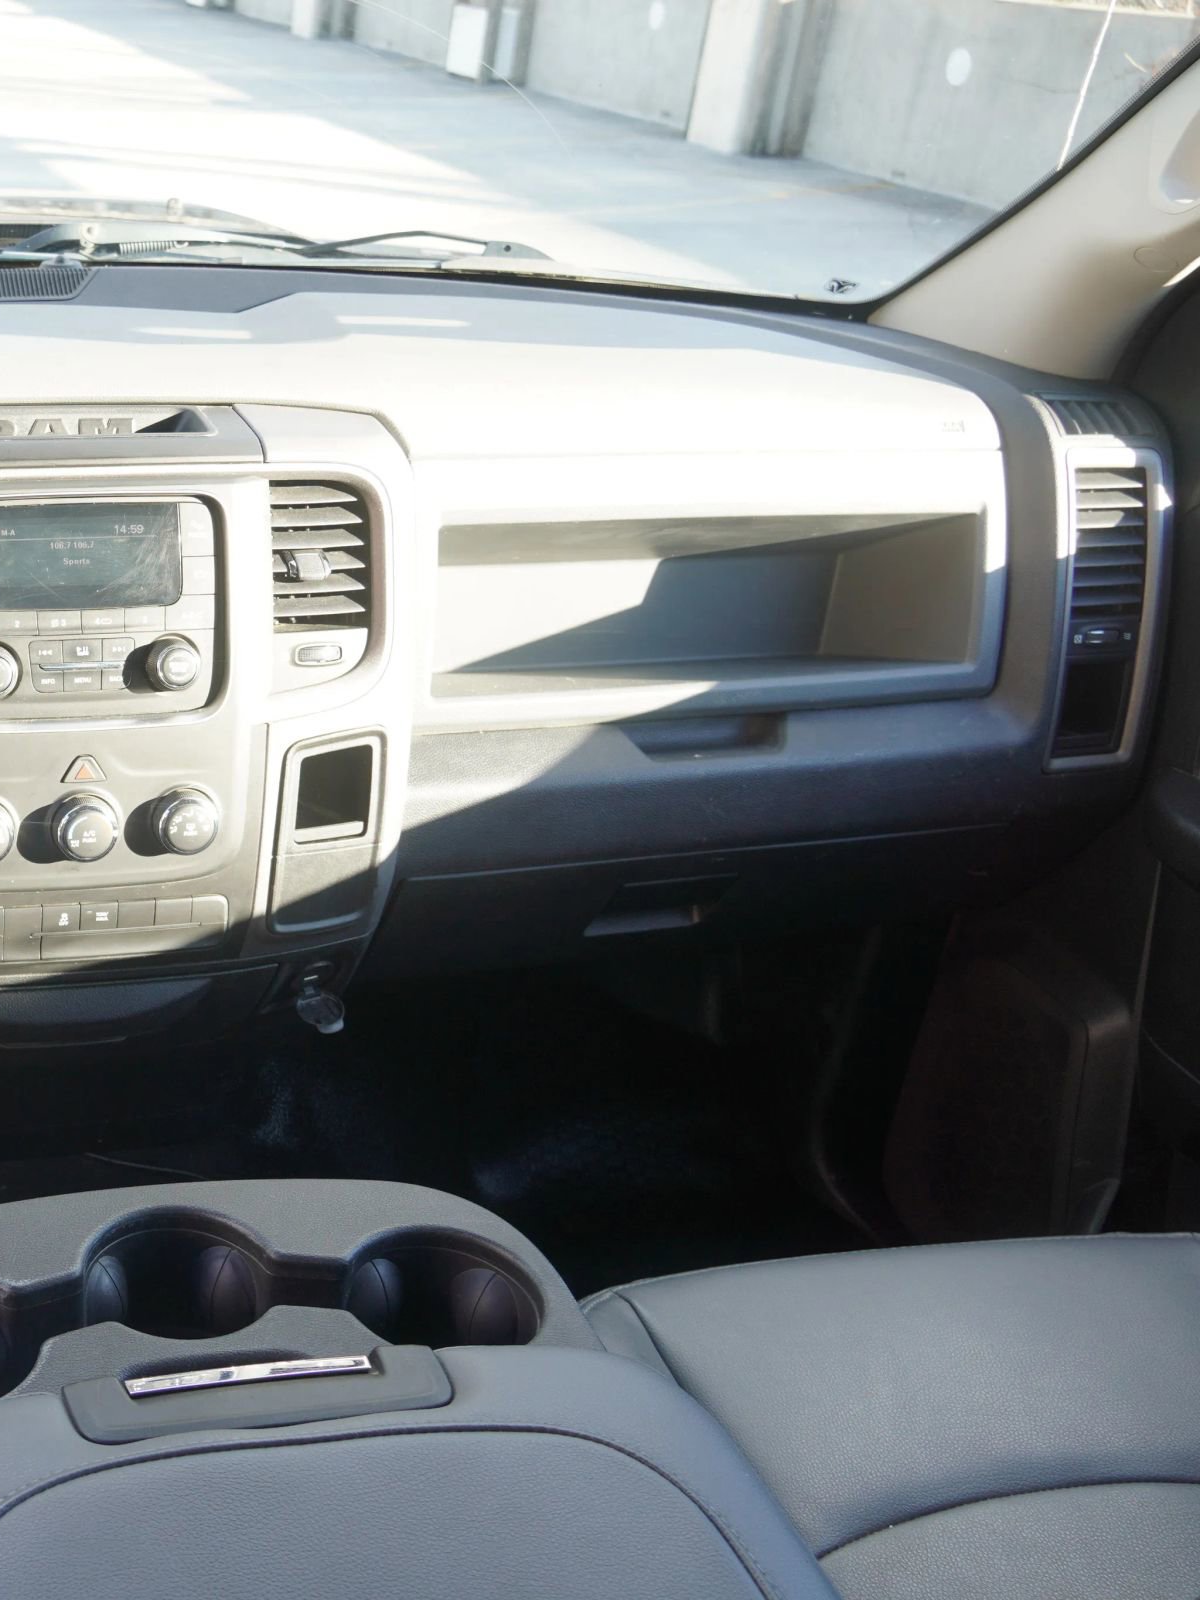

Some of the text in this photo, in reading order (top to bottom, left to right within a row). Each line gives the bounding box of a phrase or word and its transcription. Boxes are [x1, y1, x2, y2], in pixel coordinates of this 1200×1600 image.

[113, 524, 145, 535] 14:59
[63, 557, 91, 566] Sports
[15, 620, 20, 628] 2
[60, 619, 66, 627] 3
[74, 676, 92, 684] MENU
[83, 830, 96, 838] A/C
